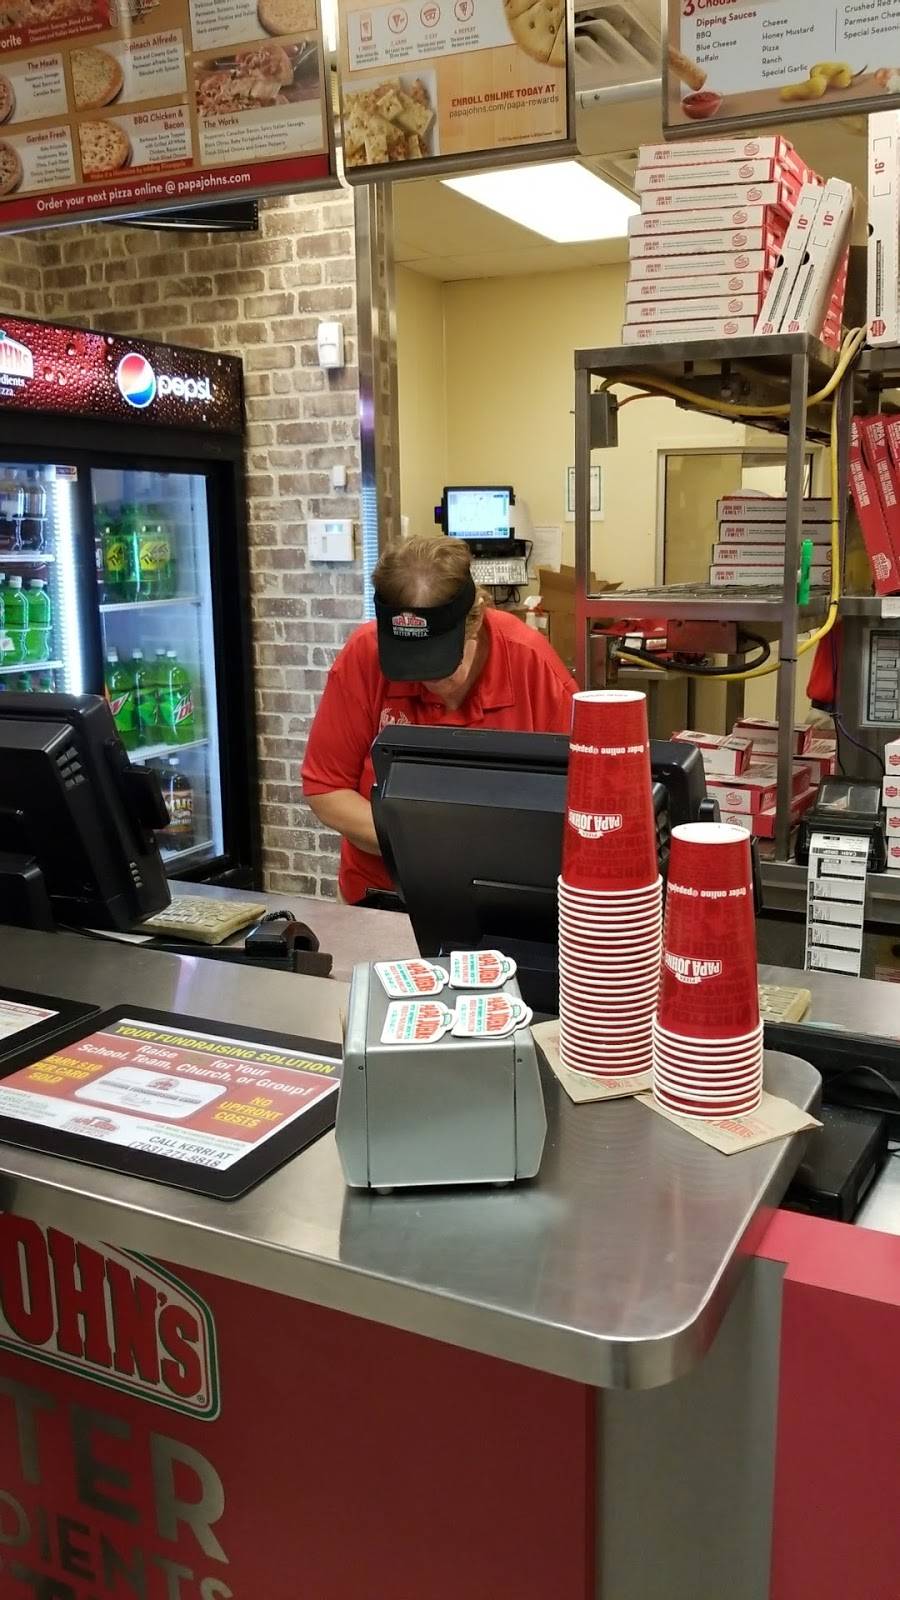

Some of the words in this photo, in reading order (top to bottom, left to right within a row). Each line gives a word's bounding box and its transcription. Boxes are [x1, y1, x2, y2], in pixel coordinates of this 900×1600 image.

[845, 3, 874, 13] Crushed
[697, 16, 727, 27] Dipping
[729, 11, 756, 21] Sauces
[762, 18, 788, 27] Cheese
[845, 15, 879, 26] Parmesan
[696, 31, 712, 40] BBQ
[762, 32, 783, 41] Honey
[786, 25, 814, 36] Mustard
[844, 28, 869, 40] Special
[152, 35, 177, 46] Alfredo
[696, 44, 711, 52] Blue
[712, 39, 737, 49] Cheese
[762, 44, 779, 53] Pizza
[27, 62, 39, 71] The
[40, 58, 58, 69] Meats
[762, 56, 782, 65] Ranch
[761, 67, 786, 78] Special
[788, 64, 809, 75] Garlic
[451, 93, 483, 107] ENROLL
[484, 90, 514, 103] ONLINE
[516, 86, 542, 99] TODAY
[543, 84, 556, 94] AT
[449, 95, 559, 119] papajohns.com/papa-rewards
[134, 115, 149, 125] BBQ
[150, 111, 177, 123] Chicken
[178, 109, 183, 117] &
[219, 118, 239, 126] Works
[164, 122, 185, 130] Bacon
[50, 131, 66, 141] Fresh
[37, 199, 64, 211] Order
[65, 197, 84, 209] your
[87, 191, 108, 204] next
[109, 188, 132, 202] pizza
[134, 183, 162, 196] online
[164, 180, 176, 194] @
[178, 173, 251, 192] papajohns.com
[157, 374, 212, 401] pepsi
[601, 746, 625, 756] online
[594, 814, 620, 831] PAPA
[701, 890, 727, 899] online
[729, 887, 746, 897] Order
[692, 961, 719, 976] PAPA
[114, 1026, 160, 1042] YOUR
[155, 1032, 256, 1061] FUNDRAISING
[256, 1053, 336, 1075] SOLUTION
[136, 1044, 179, 1060] Raise
[32, 1062, 56, 1073] PER
[58, 1066, 90, 1079] CARD
[77, 1043, 130, 1062] School,
[129, 1053, 170, 1071] Team,
[175, 1062, 233, 1082] Church,
[236, 1076, 255, 1086] or
[255, 1079, 314, 1097] Group!
[210, 1059, 234, 1071] for
[235, 1062, 271, 1078] Your
[29, 1072, 64, 1084] SOLD
[250, 1096, 273, 1108] NO
[219, 1099, 284, 1122] UPFRONT
[213, 1110, 260, 1128] COSTS
[149, 1136, 178, 1147] CALL
[178, 1144, 215, 1156] KERRI
[0, 1212, 203, 1398] OHN'S
[0, 1375, 230, 1565] TER
